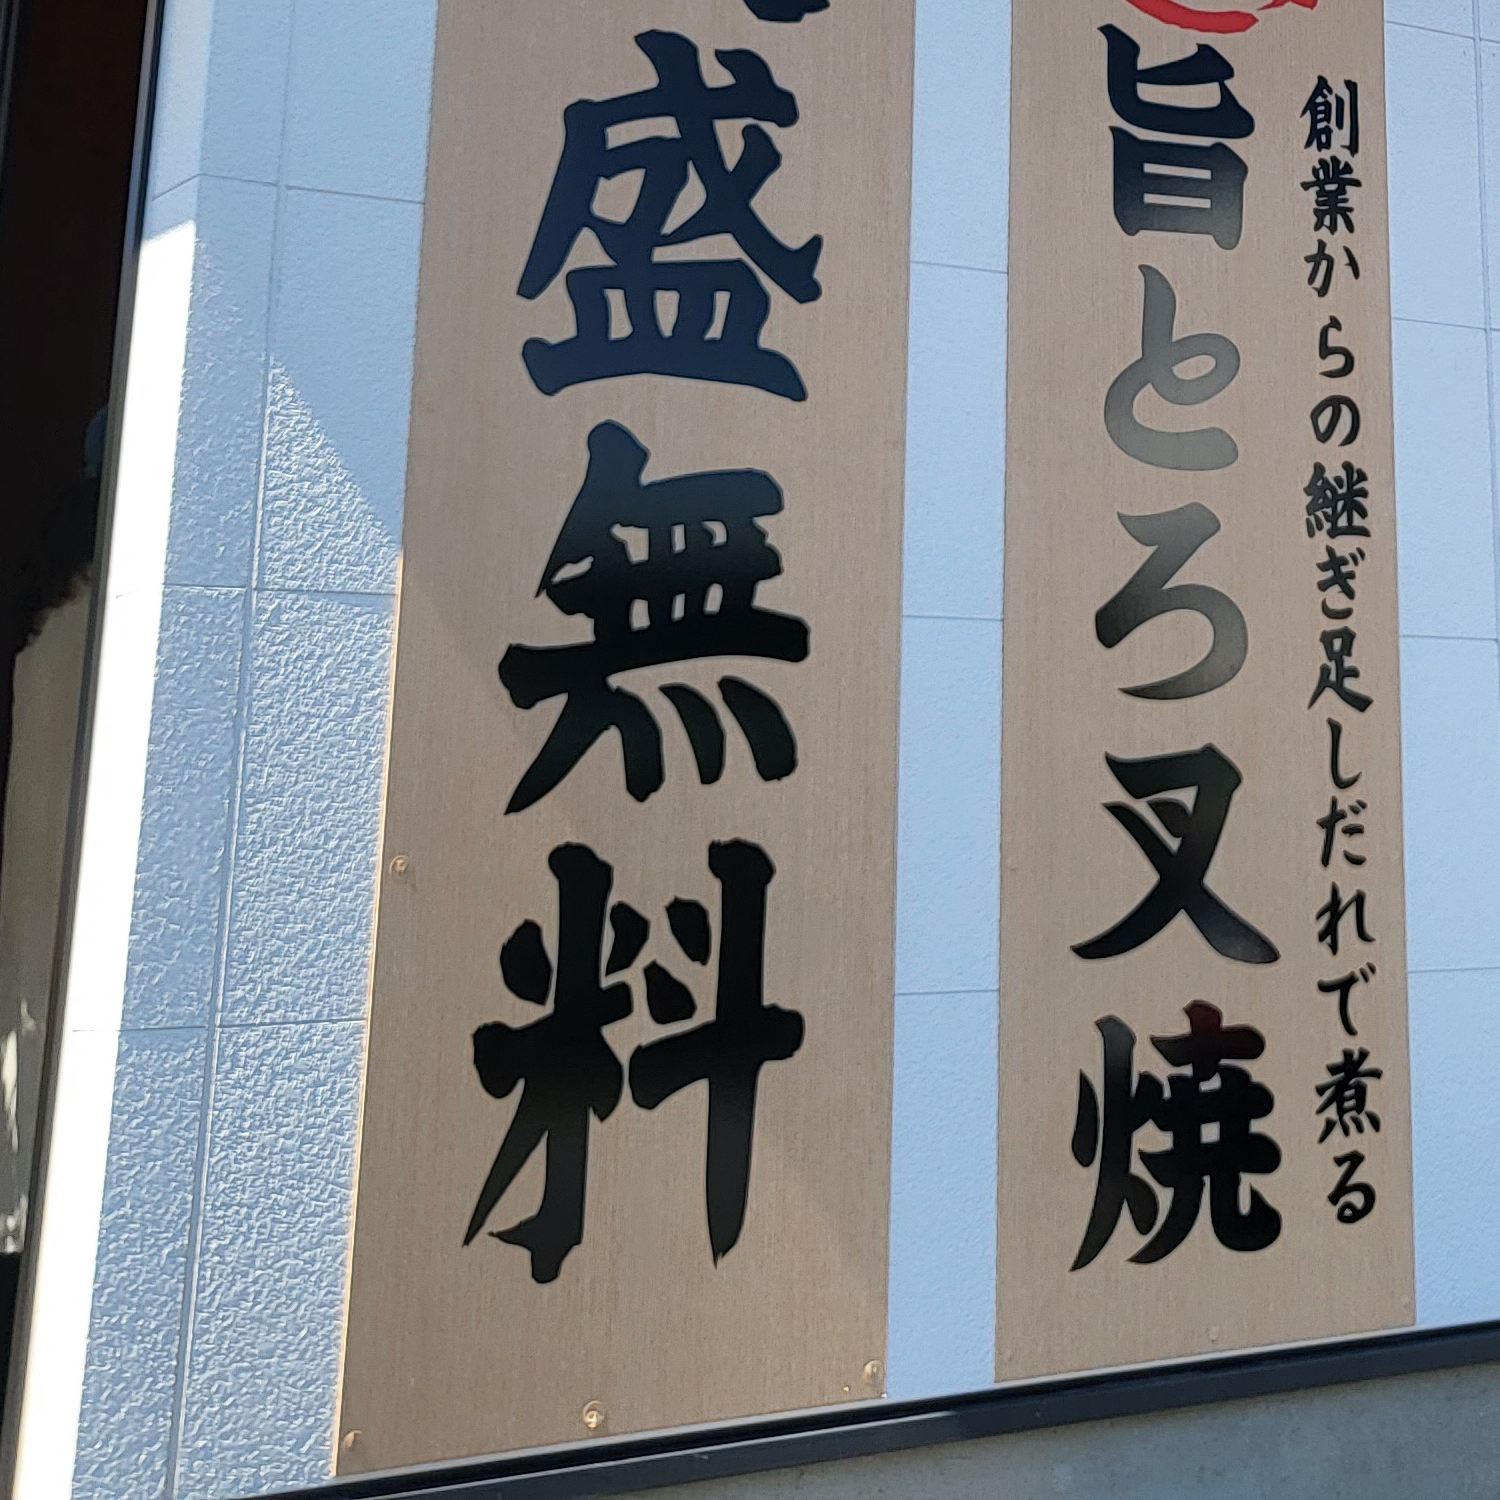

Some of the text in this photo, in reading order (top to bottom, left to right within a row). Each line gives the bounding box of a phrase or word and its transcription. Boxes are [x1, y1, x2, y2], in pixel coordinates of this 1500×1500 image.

[1069, 24, 1282, 1272] 旨とろ叉焼
[1300, 75, 1383, 1224] 創業からの継ぎ足しだれで煮る
